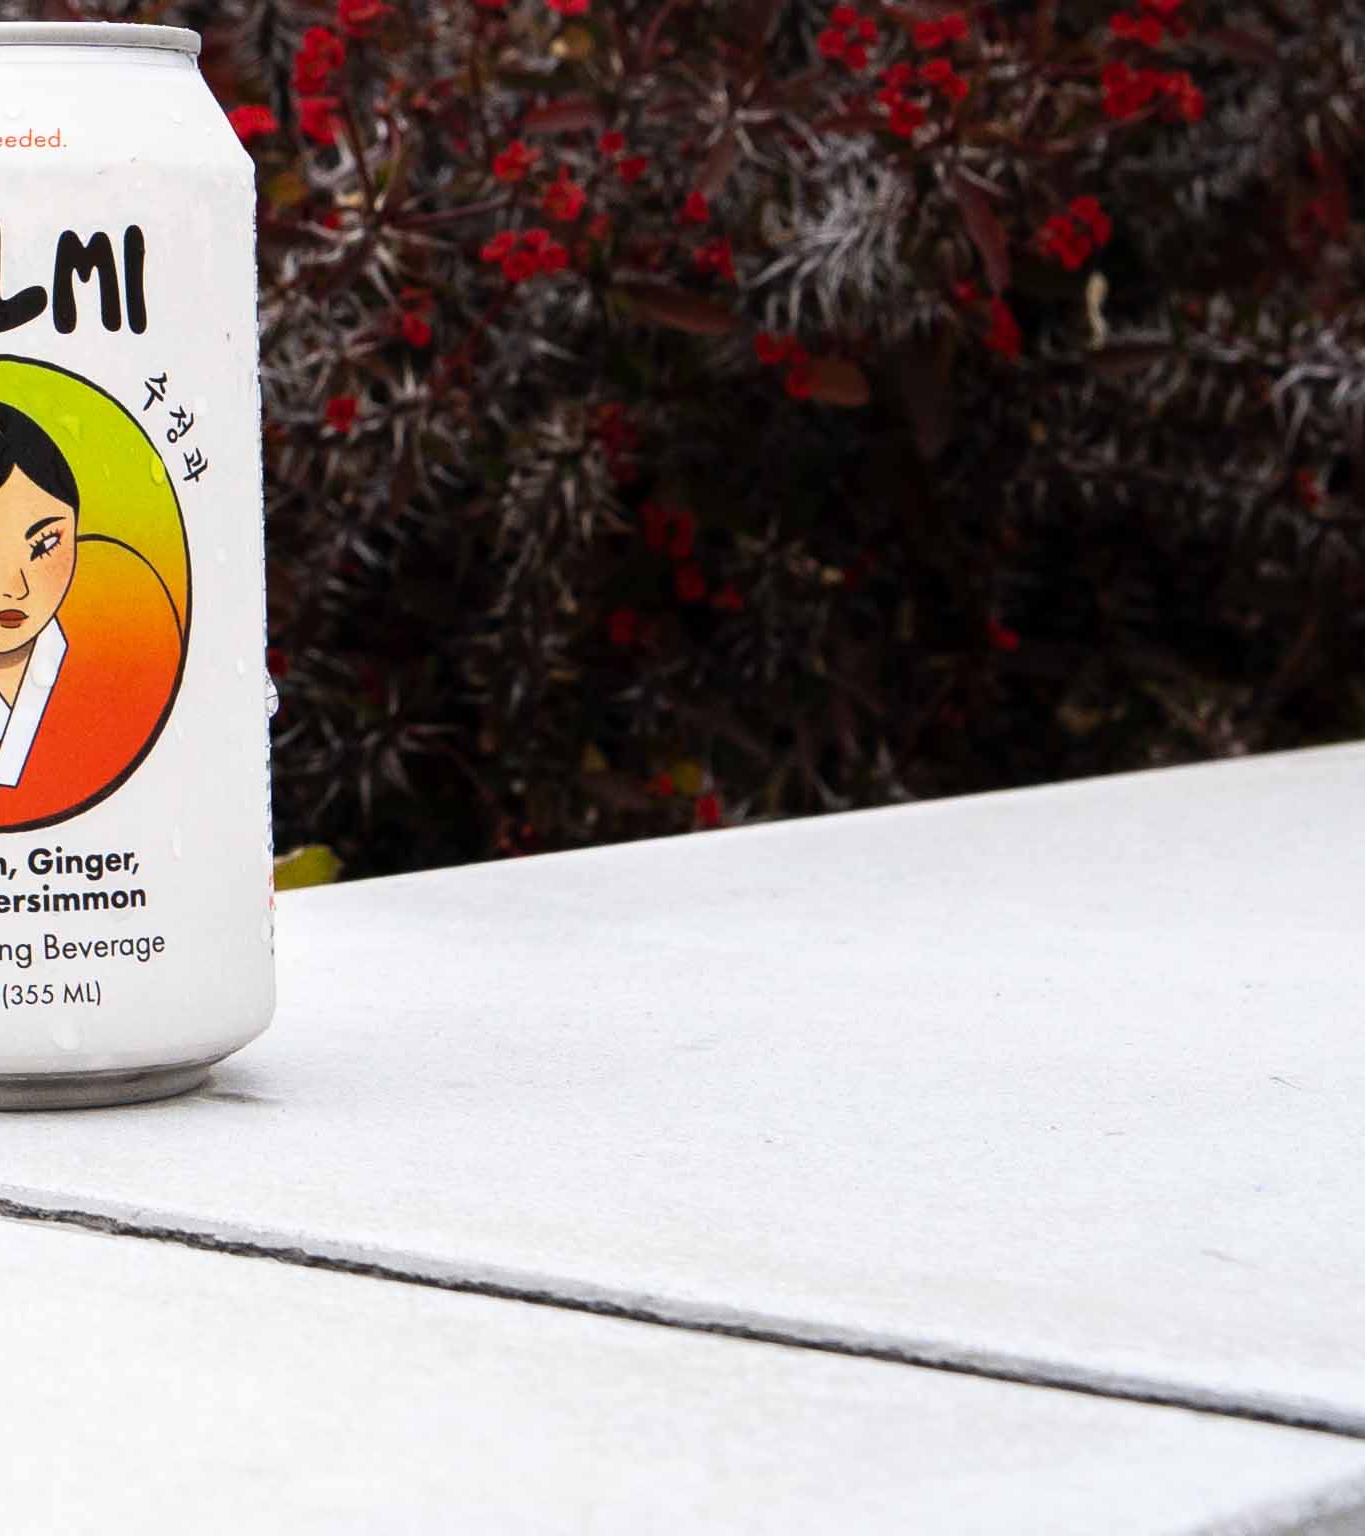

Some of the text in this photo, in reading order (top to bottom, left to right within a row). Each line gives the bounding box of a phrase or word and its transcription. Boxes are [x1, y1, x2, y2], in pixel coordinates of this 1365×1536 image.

[27, 845, 140, 882] Ginger,
[43, 933, 166, 963] Beverage
[2, 983, 54, 1010] (355
[63, 980, 101, 1007] ML)
